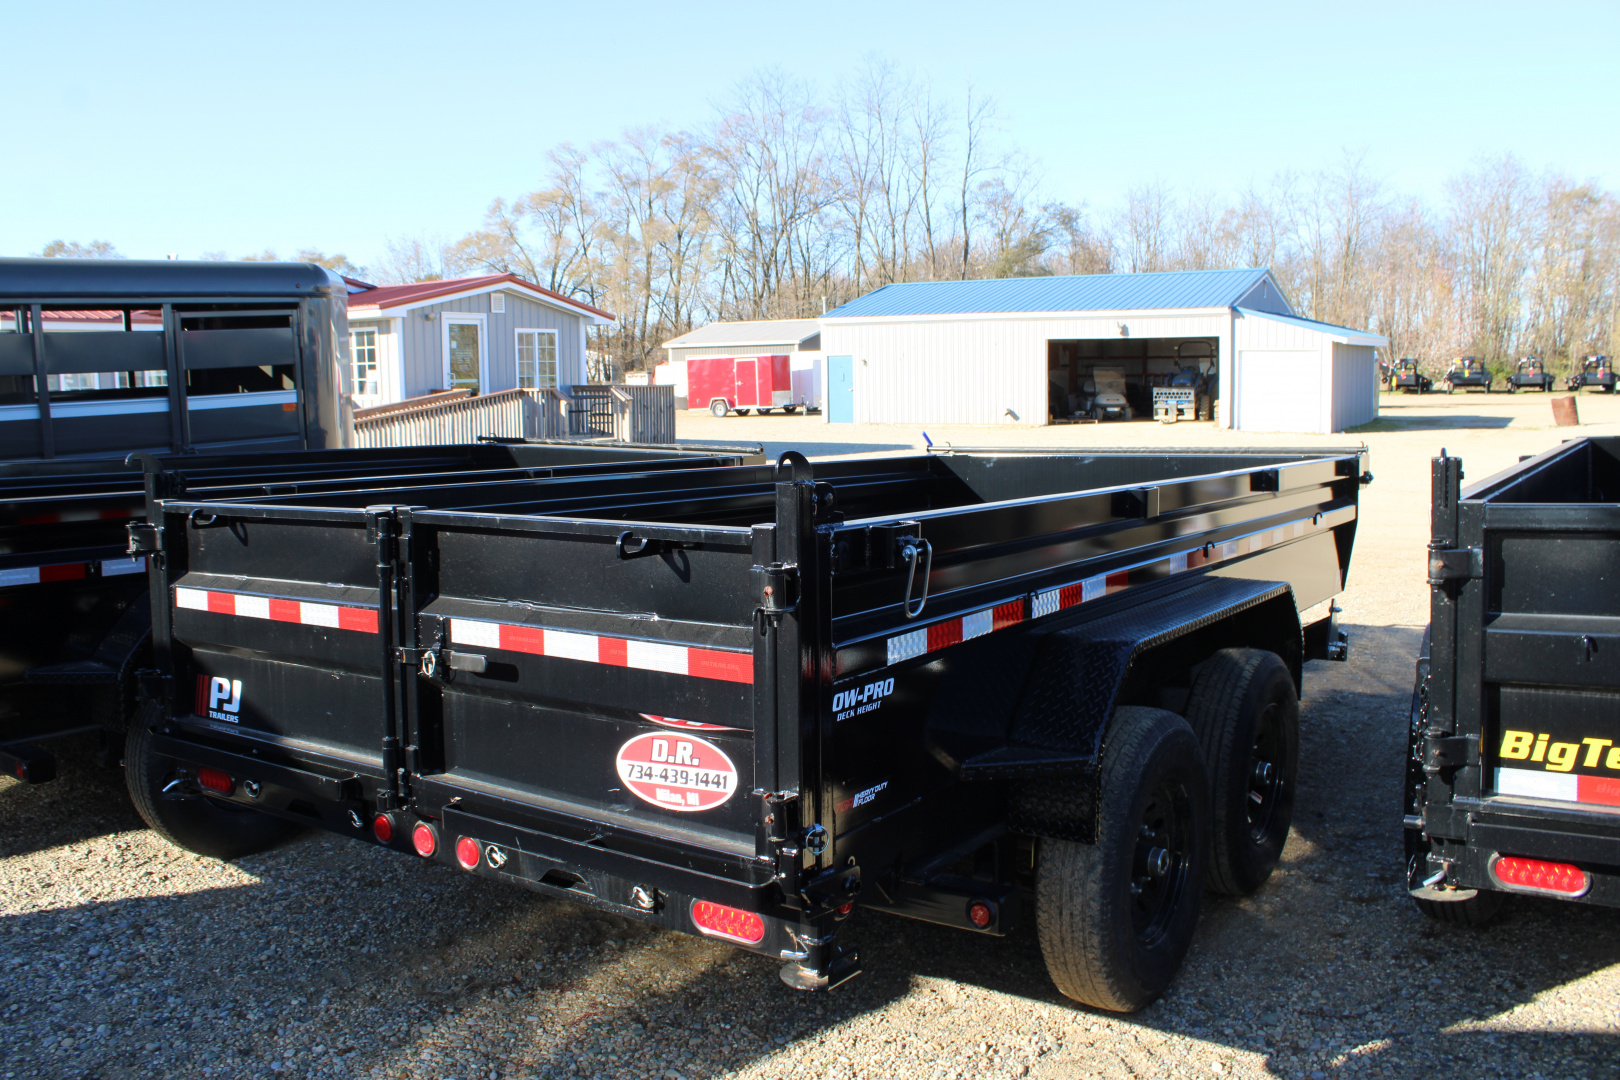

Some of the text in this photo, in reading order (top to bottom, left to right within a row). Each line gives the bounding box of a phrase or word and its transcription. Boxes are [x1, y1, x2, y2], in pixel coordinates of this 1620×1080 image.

[209, 676, 242, 713] PJ
[832, 677, 894, 712] OW-PRO
[209, 710, 239, 723] TRAILERS
[836, 700, 882, 722] DECK HEIGHT
[651, 738, 700, 767] D.R.
[627, 763, 729, 790] 734-439-1441
